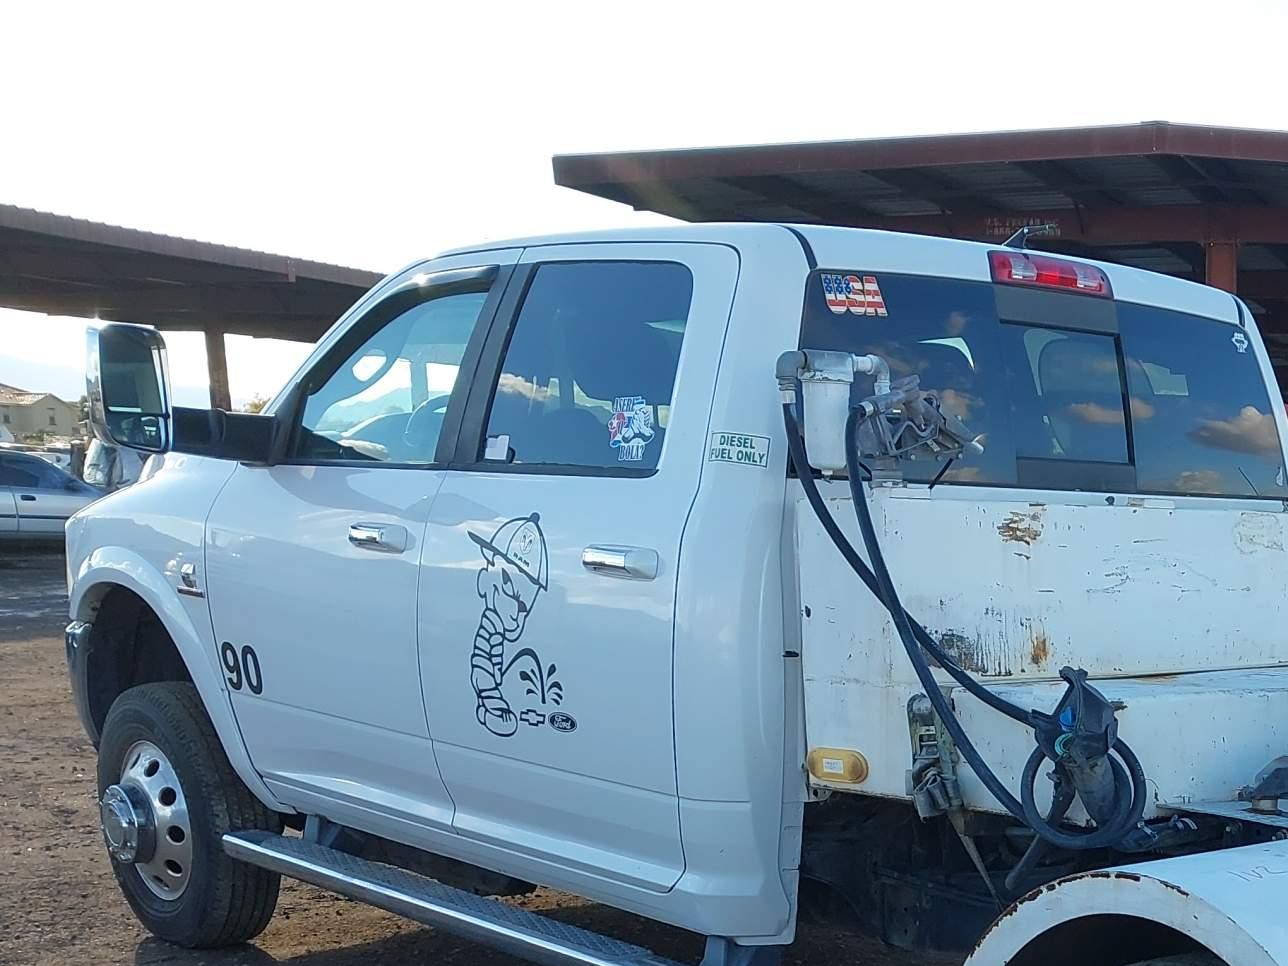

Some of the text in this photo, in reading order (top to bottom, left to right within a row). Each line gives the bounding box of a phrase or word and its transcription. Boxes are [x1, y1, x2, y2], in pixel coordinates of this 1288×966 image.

[821, 273, 888, 316] USA
[719, 434, 756, 449] DIESEL
[710, 447, 766, 464] FUEL ONLY
[512, 551, 531, 568] RAM
[221, 641, 263, 695] 90
